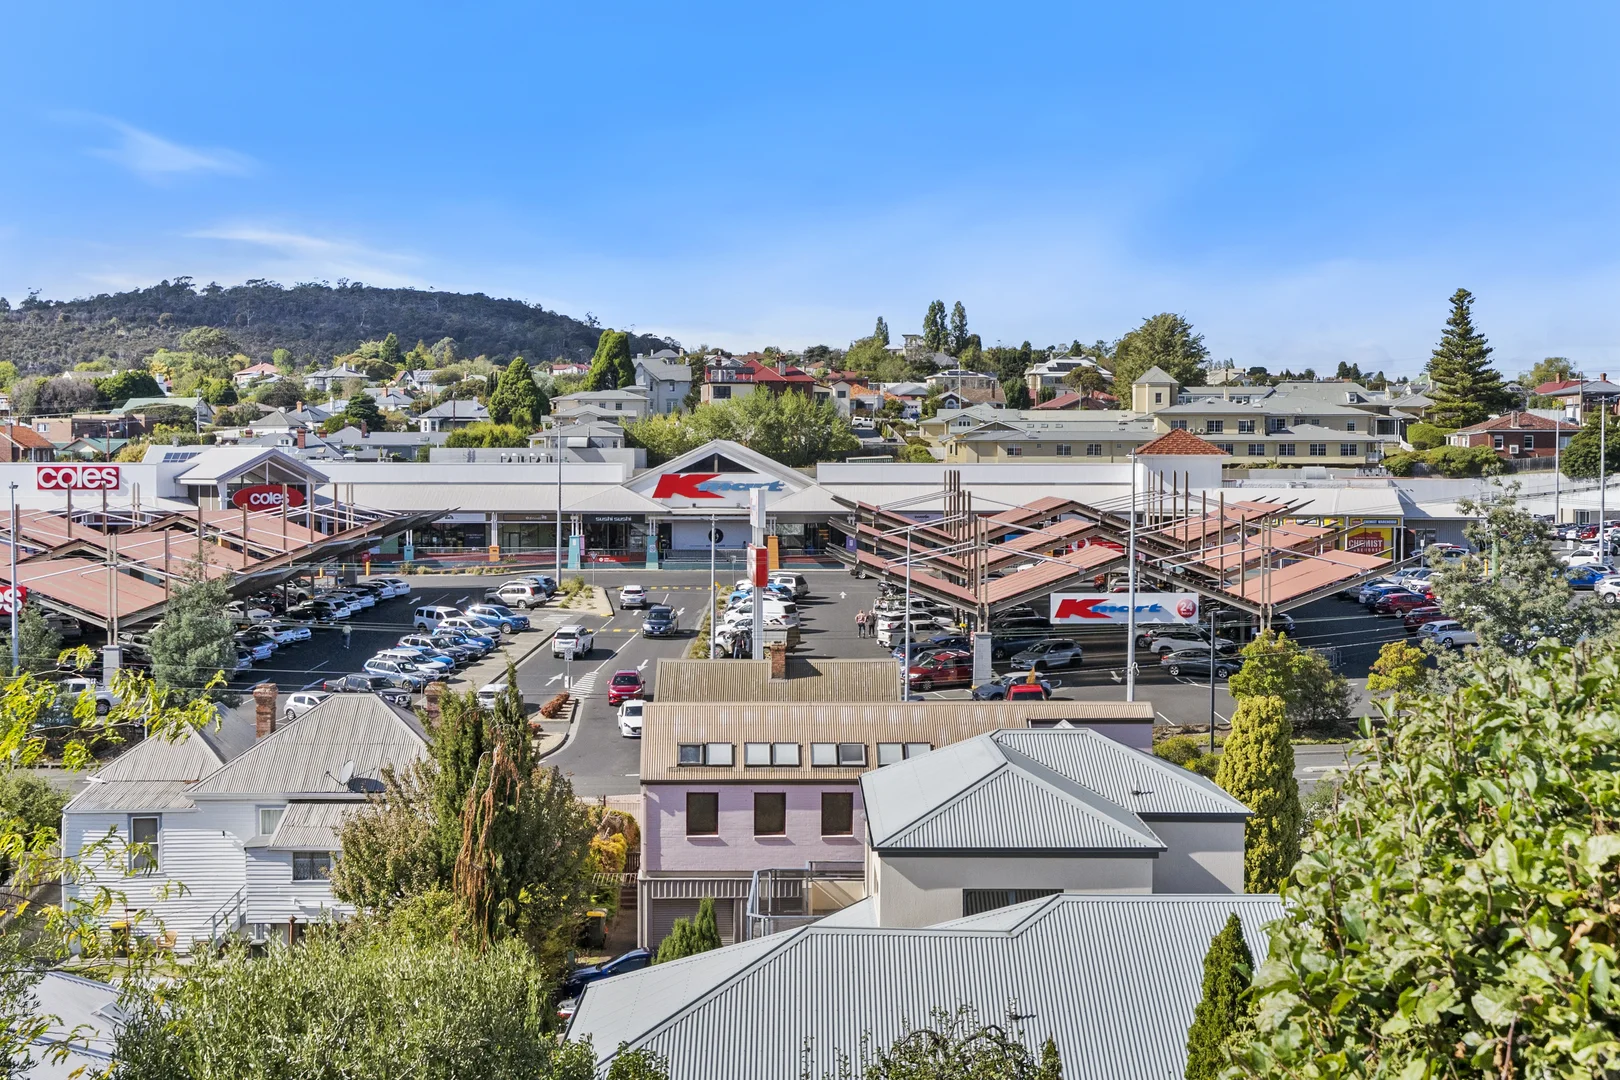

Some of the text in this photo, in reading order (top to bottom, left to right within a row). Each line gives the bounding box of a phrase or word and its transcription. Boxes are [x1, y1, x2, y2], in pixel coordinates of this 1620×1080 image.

[38, 466, 118, 489] coles
[652, 474, 785, 499] Kmart
[1348, 539, 1383, 548] CHEMIST
[1054, 599, 1162, 619] Kmart
[1180, 602, 1193, 611] 24
